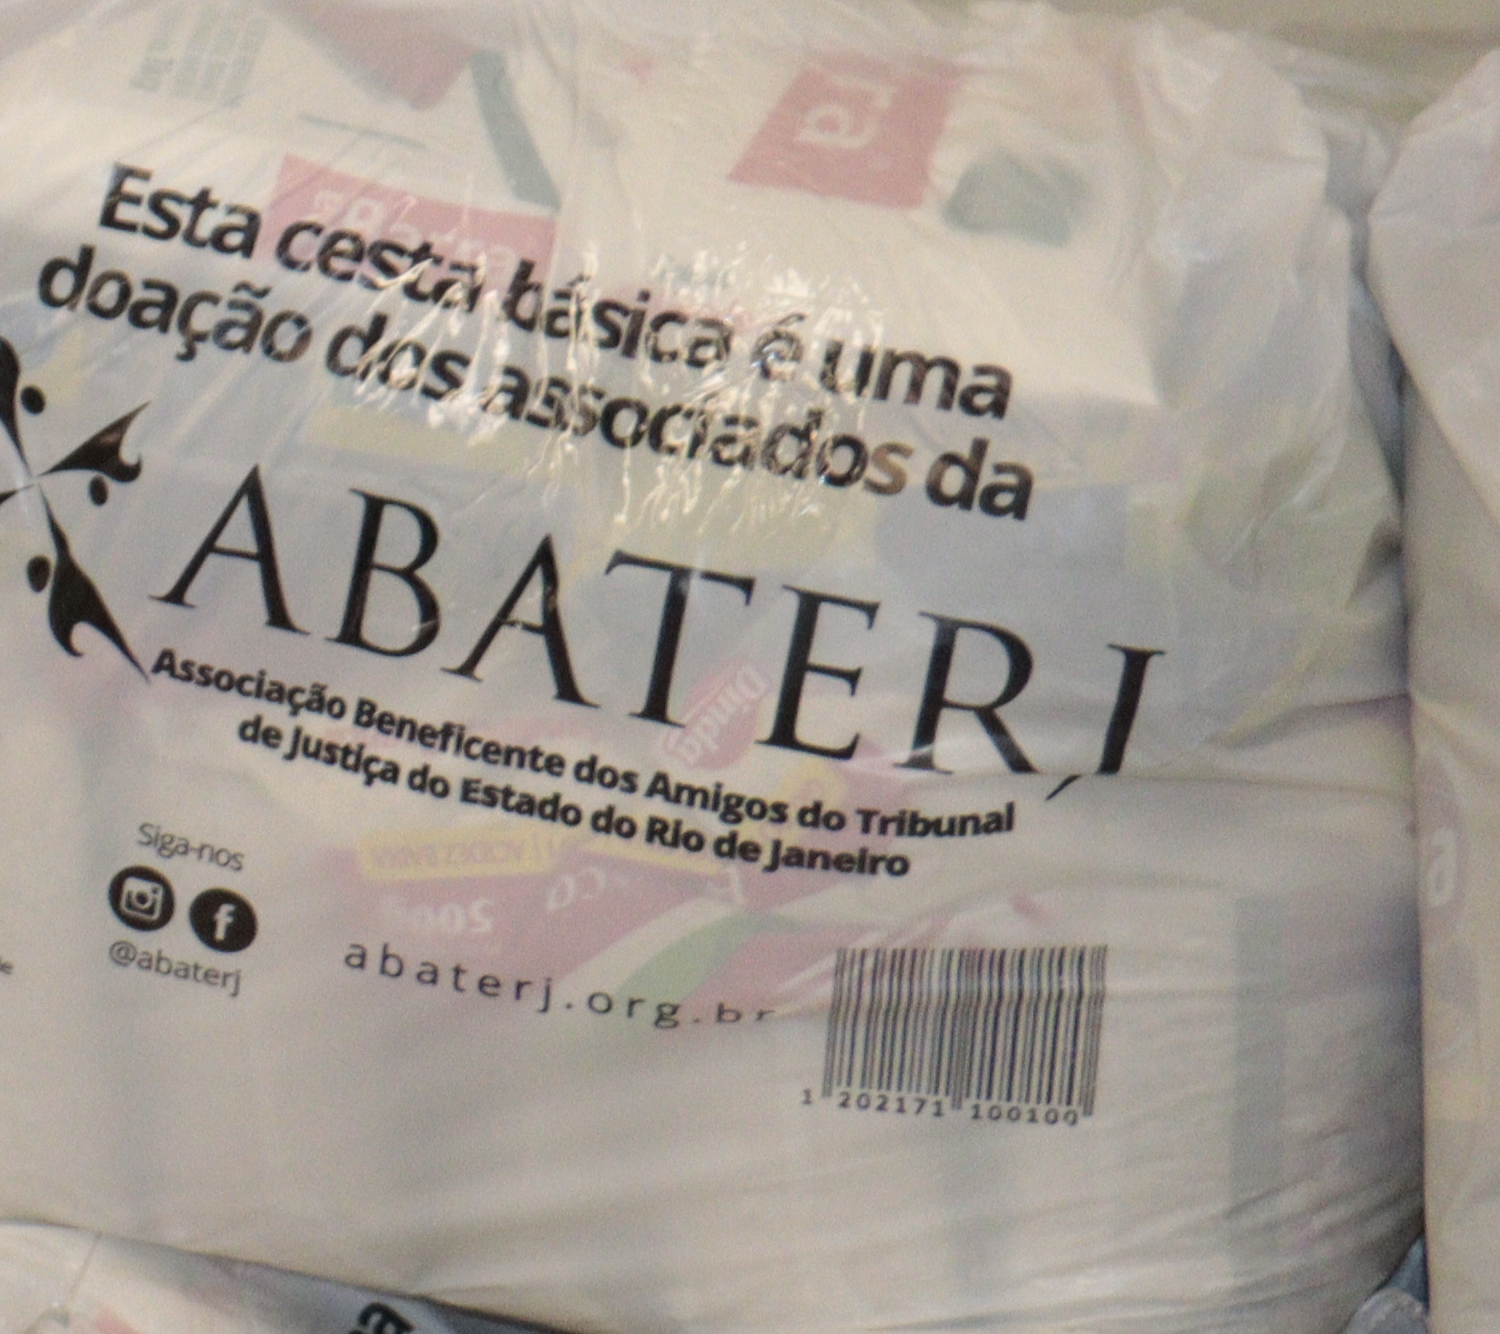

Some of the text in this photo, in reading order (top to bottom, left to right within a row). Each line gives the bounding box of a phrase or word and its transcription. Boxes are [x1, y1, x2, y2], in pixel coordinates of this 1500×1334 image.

[100, 163, 262, 259] Esta
[275, 219, 486, 313] cesta
[503, 260, 733, 370] básica
[751, 312, 806, 382] é
[820, 337, 1014, 421] uma
[38, 245, 1035, 521] doação dos associados da
[148, 463, 1167, 802] ABATERJ
[152, 647, 1016, 838] Associação Beneficente dos Amigos do Tribunal
[238, 715, 911, 877] de Justiça do Estado do Rio de Janeiro
[137, 822, 246, 871] Siga-nos
[109, 940, 243, 997] @abaterj
[343, 936, 777, 1030] abaterj.org.br
[838, 1091, 945, 1118] 202171
